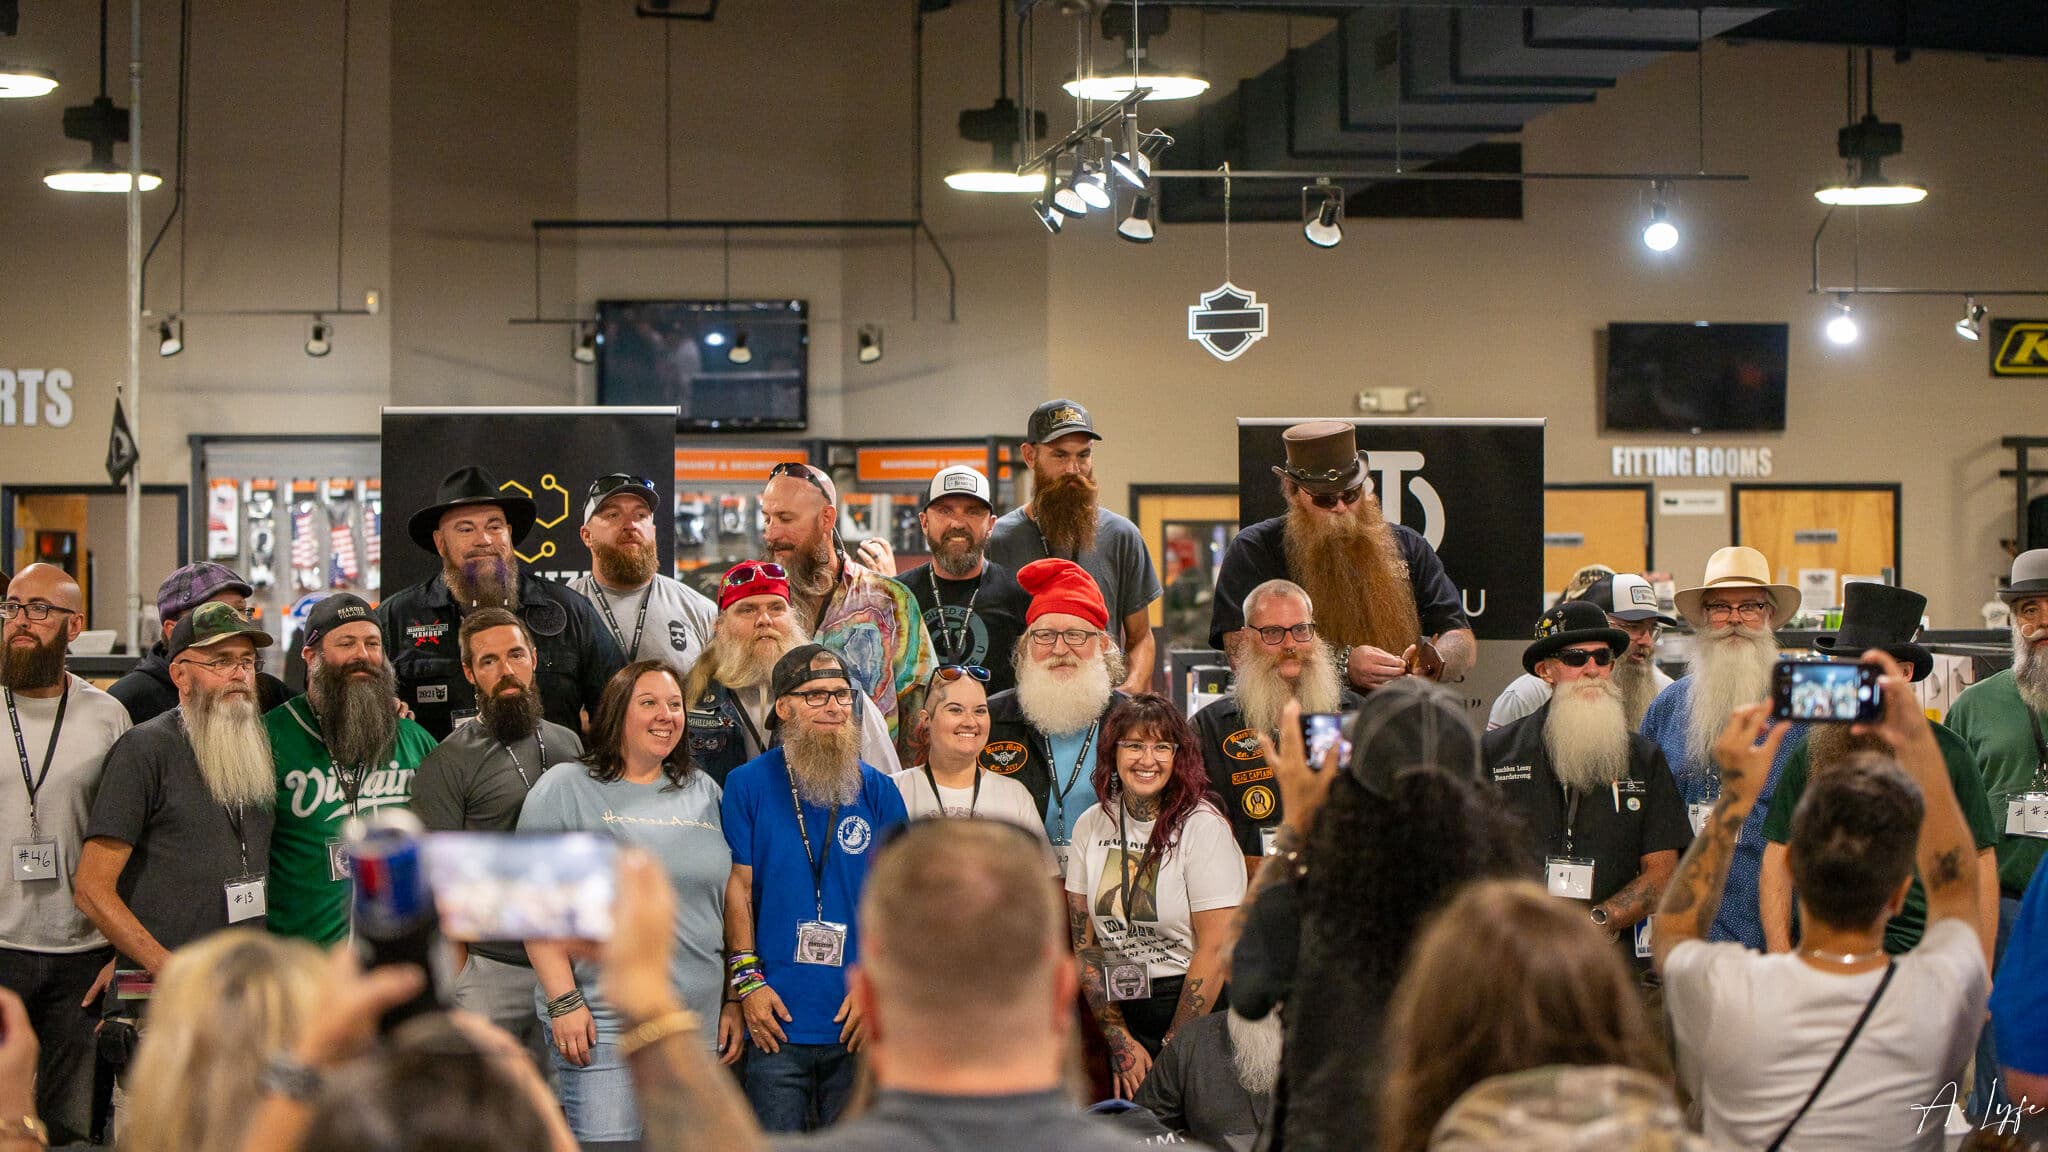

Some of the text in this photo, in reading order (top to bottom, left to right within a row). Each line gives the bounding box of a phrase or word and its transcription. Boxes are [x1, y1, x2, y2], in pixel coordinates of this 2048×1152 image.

[1612, 446, 1772, 477] FITTING ROOMS
[1248, 767, 1274, 780] CAPTAIN
[1494, 773, 1531, 782] Beardstrong
[18, 849, 51, 867] #46
[233, 891, 254, 904] #13
